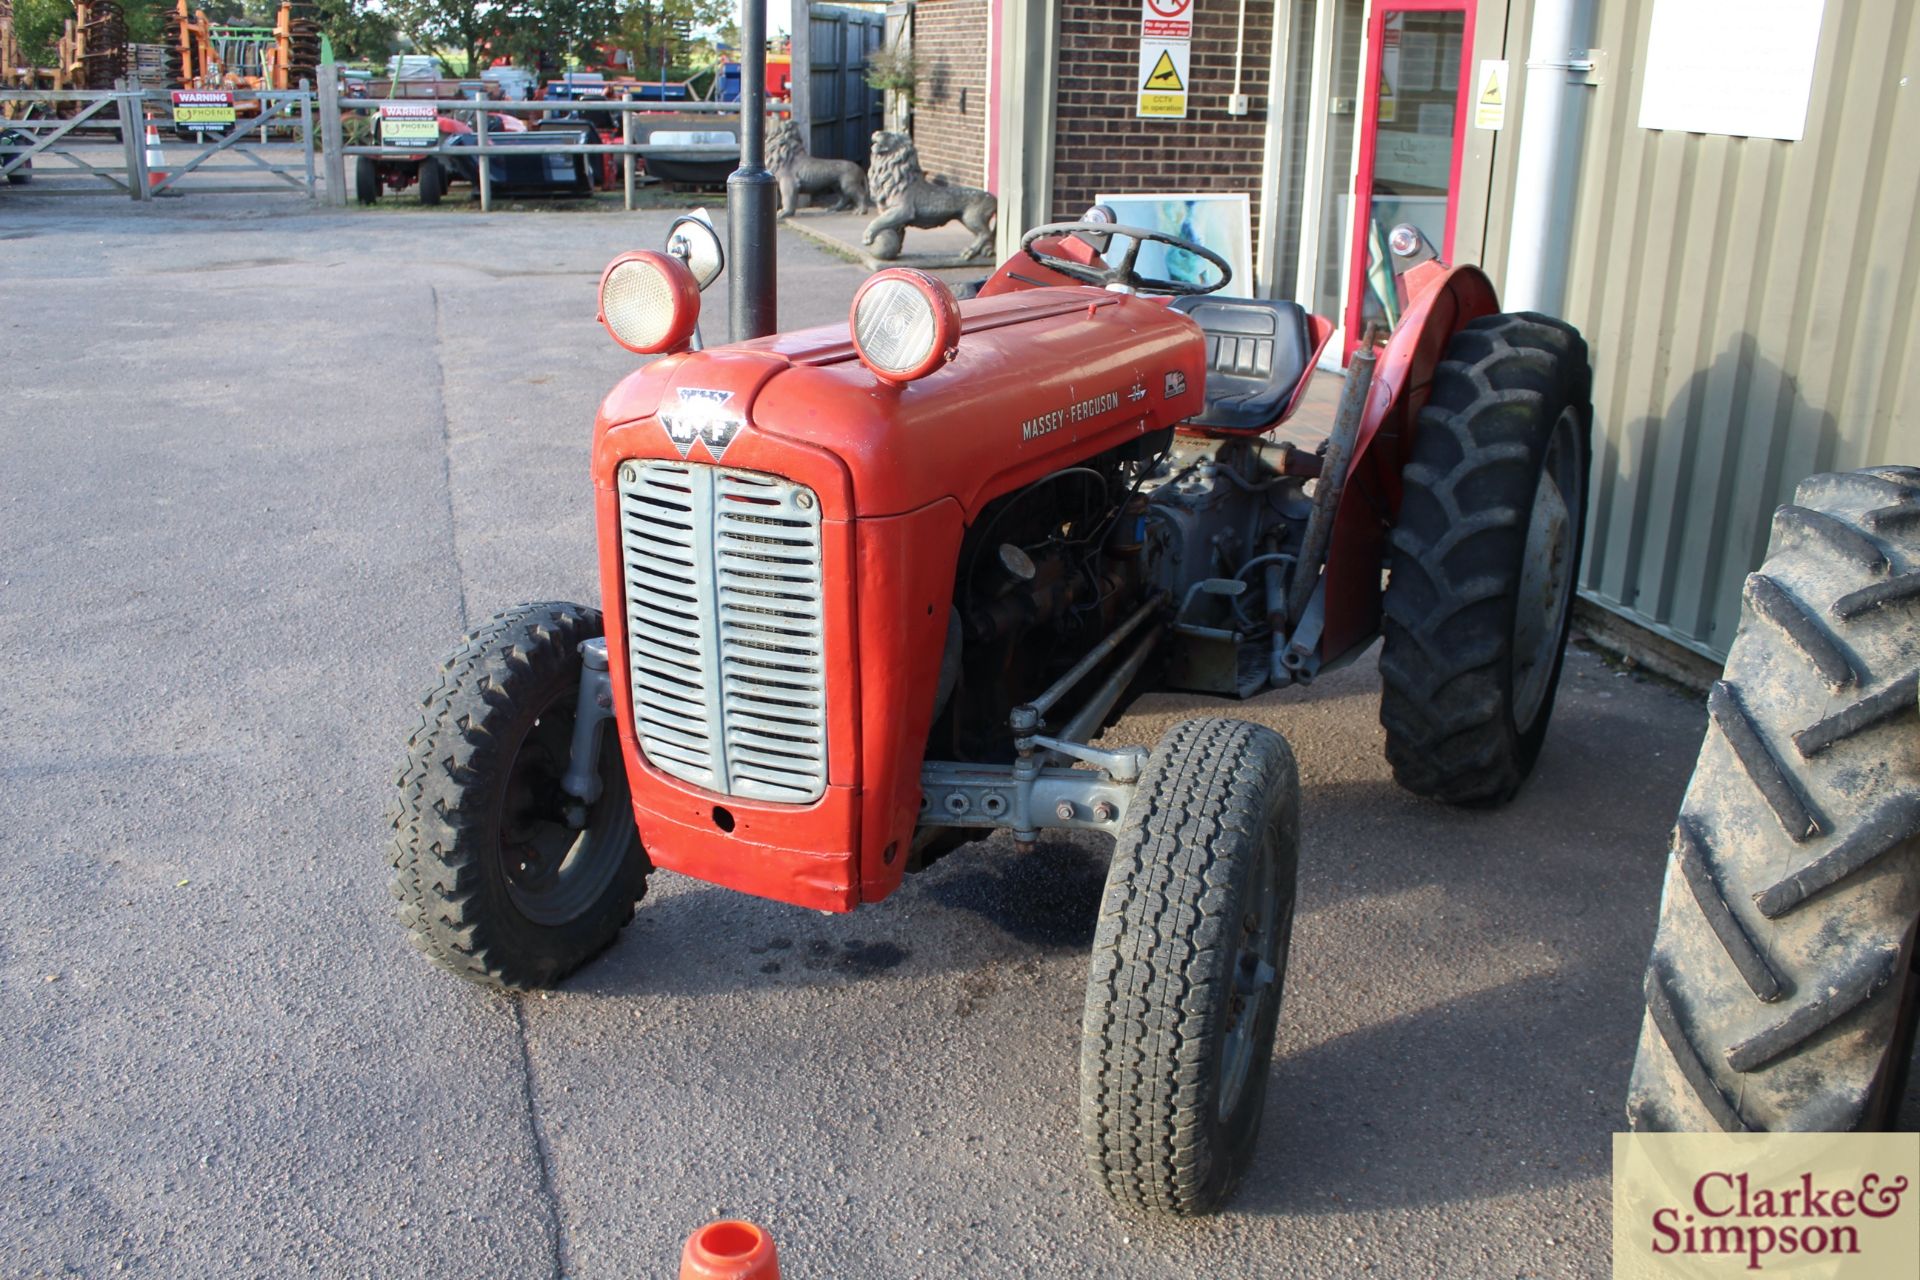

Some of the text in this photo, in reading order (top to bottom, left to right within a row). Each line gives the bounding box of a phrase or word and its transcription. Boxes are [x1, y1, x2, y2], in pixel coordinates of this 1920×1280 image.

[178, 93, 228, 102] WARNING
[387, 107, 433, 116] WARNING
[1151, 104, 1183, 112] operation
